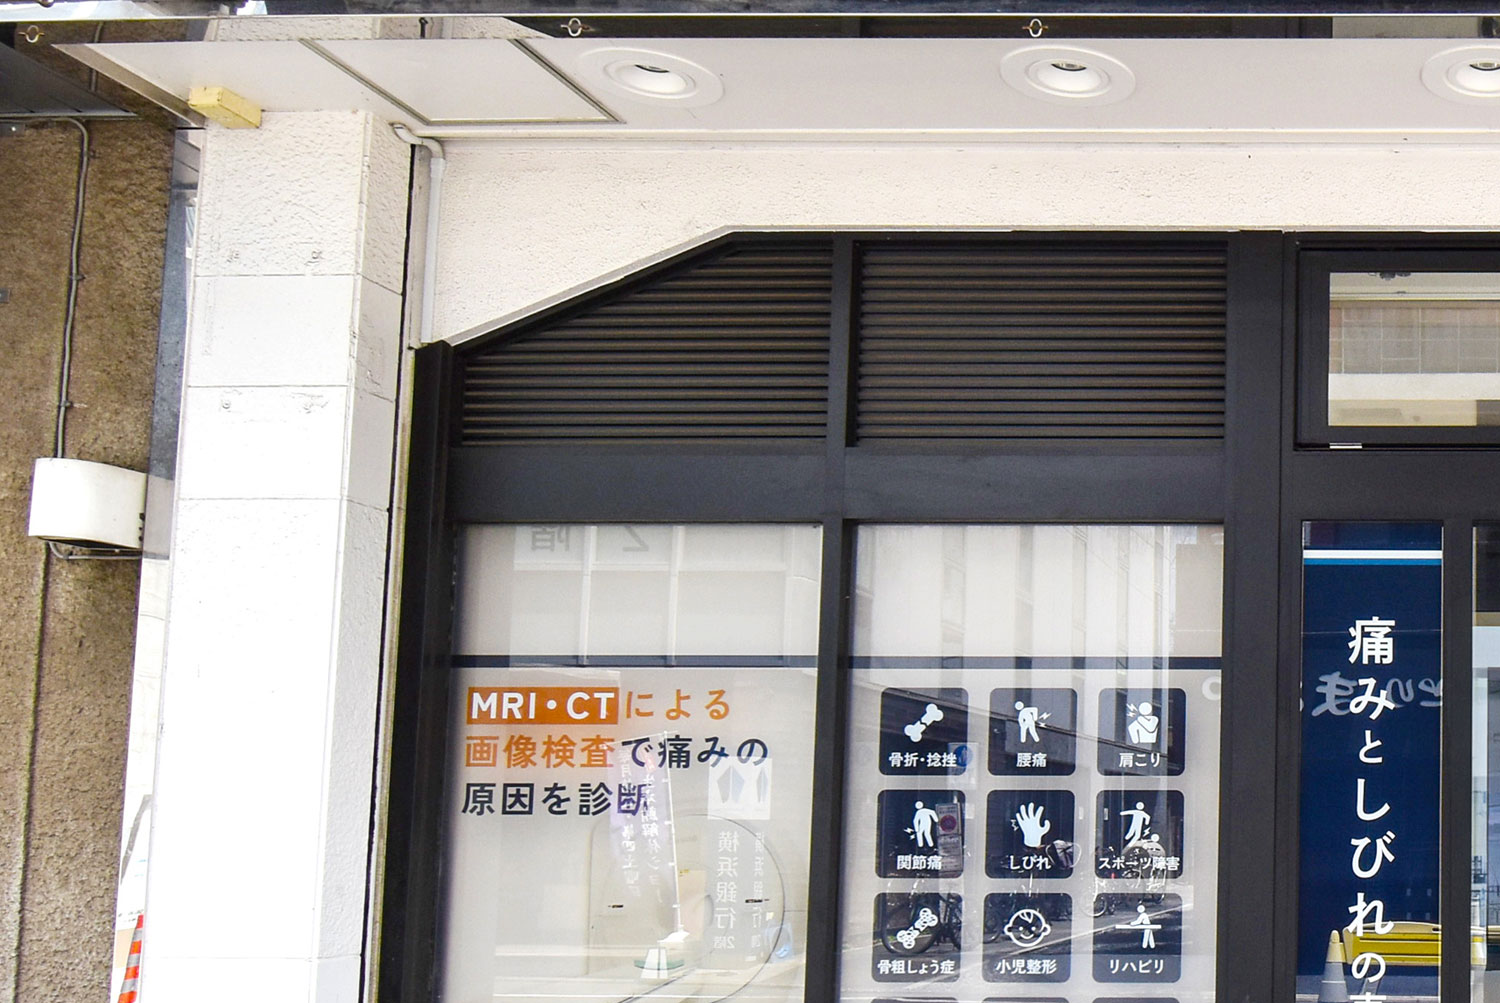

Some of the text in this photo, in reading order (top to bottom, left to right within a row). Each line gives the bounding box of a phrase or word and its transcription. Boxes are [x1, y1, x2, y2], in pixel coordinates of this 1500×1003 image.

[465, 734, 769, 769] 画像検査で痛みの
[889, 752, 957, 768] 骨折・捻挫
[1016, 752, 1047, 768] 腰痛
[1119, 752, 1161, 768] 肩こり
[461, 782, 651, 816] 原因を診断
[897, 855, 942, 870] 関節痛
[1009, 855, 1051, 870] しびれ
[1099, 856, 1180, 870] スポーツ障害
[878, 960, 955, 975] 骨粗しょう症
[996, 960, 1057, 975] 小児整形
[1109, 959, 1164, 974] リハビリ
